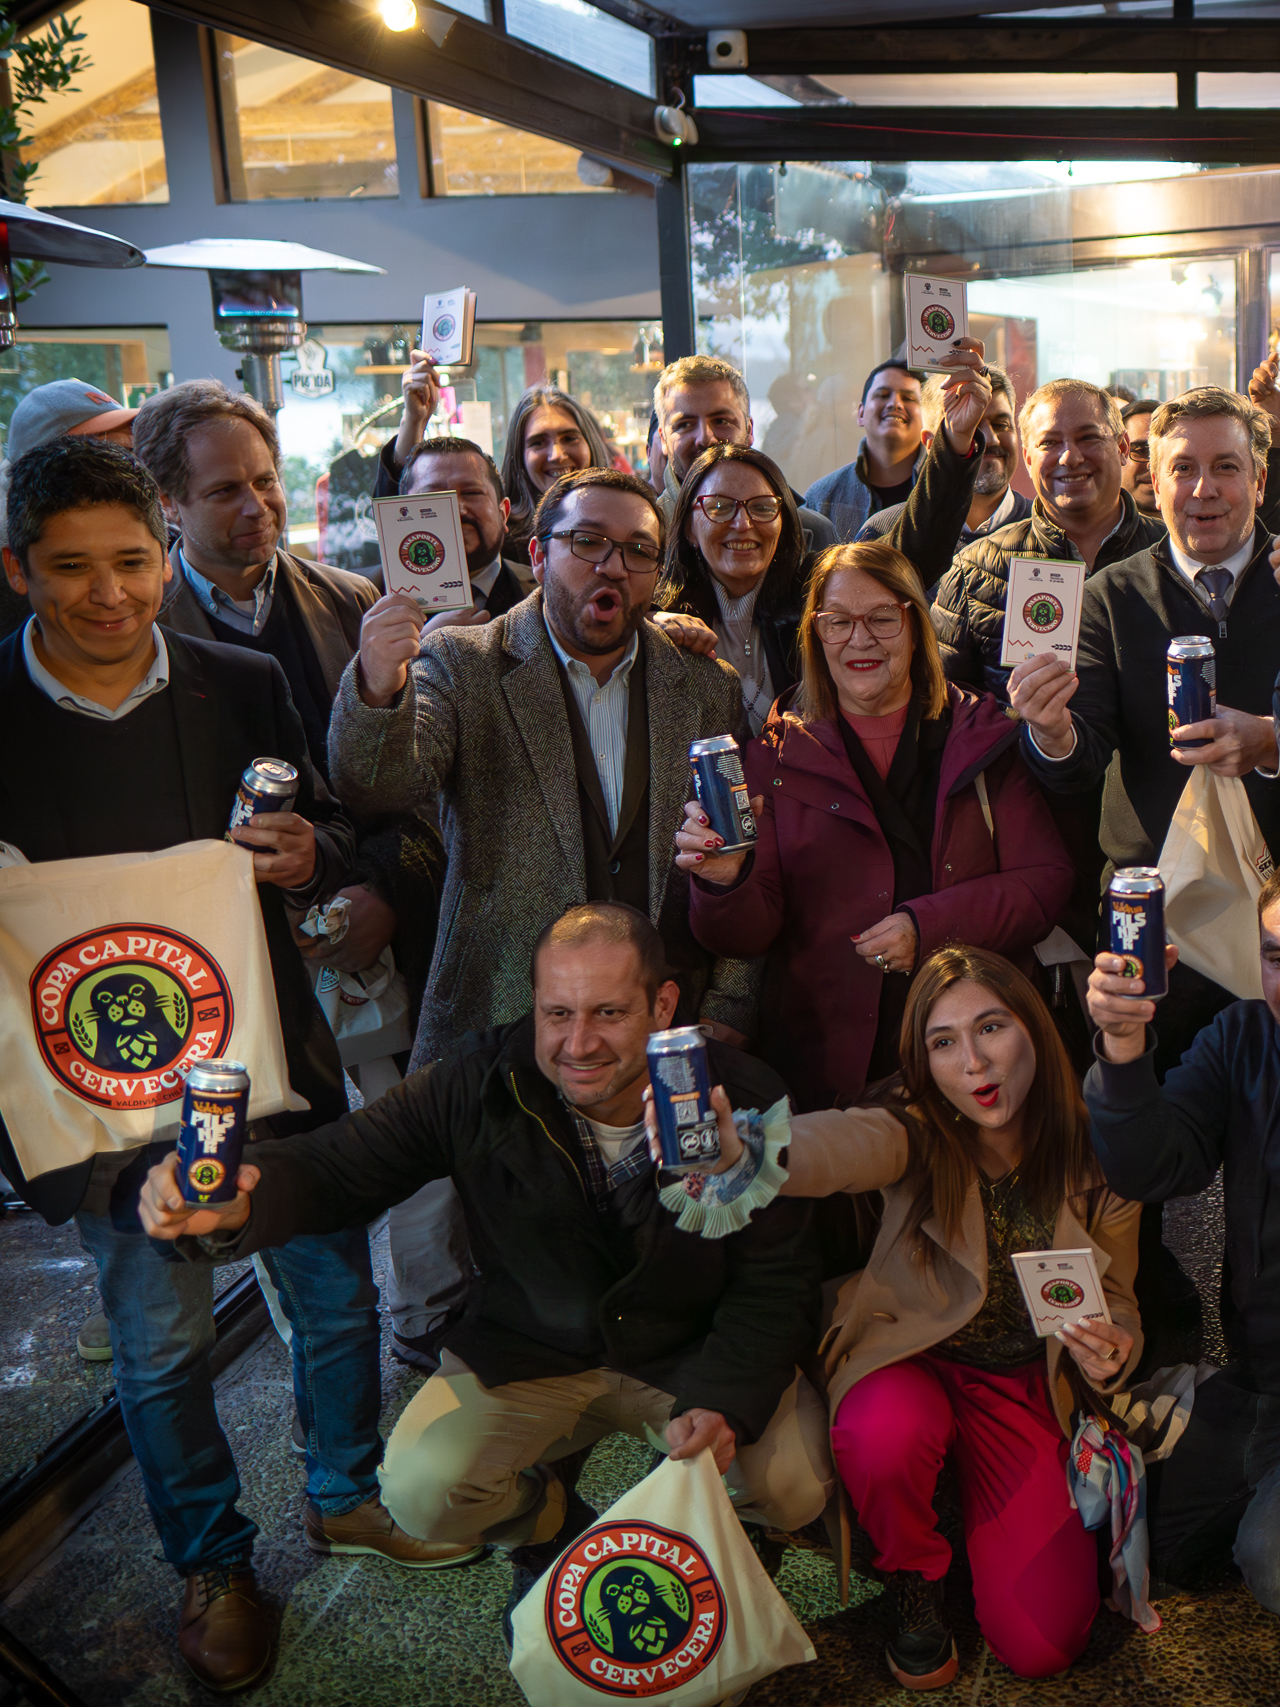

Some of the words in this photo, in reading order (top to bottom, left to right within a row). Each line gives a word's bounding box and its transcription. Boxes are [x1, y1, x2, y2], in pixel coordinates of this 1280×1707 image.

[403, 534, 438, 550] PASAPORTE
[406, 557, 440, 572] CERVECERO
[1027, 595, 1060, 610] PASAPORTE
[1027, 617, 1058, 631] CERVECERO
[41, 961, 79, 1025] COPA
[78, 935, 210, 991] CAPITAL
[70, 1030, 218, 1097] CERVECERA
[164, 1087, 184, 1101] CHIL
[559, 1562, 588, 1628] COPA
[584, 1532, 697, 1576] CAPITAL
[590, 1610, 715, 1686] CERVECERA
